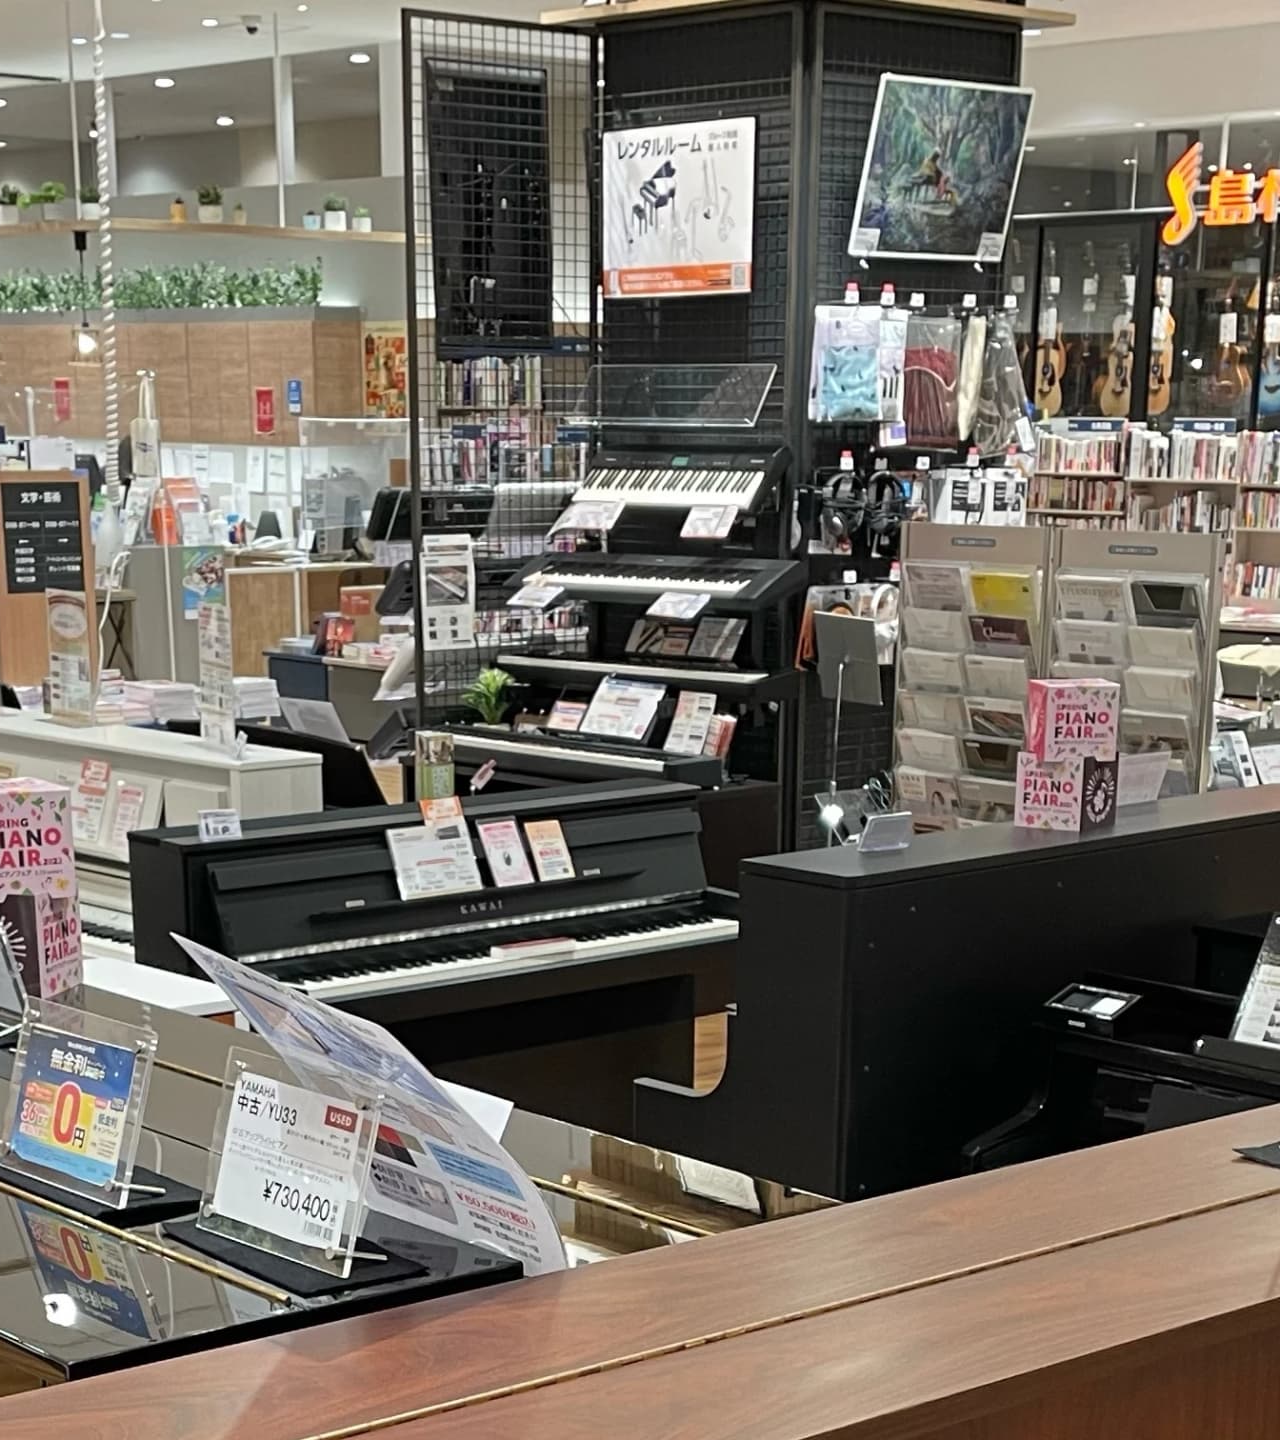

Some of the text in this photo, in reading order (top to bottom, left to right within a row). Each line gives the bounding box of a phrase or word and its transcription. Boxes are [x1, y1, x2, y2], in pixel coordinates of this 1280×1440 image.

[618, 133, 702, 159] レンタルルーム
[1055, 711, 1110, 725] PIANO
[1054, 726, 1093, 739] FAIR
[1023, 779, 1074, 793] PIANO
[1023, 792, 1059, 808] FAIR
[460, 900, 503, 914] KAWAI
[43, 917, 77, 946] PIANO
[45, 941, 69, 965] FAIR
[239, 1079, 277, 1100] YAMAHA
[237, 1094, 298, 1126] 中古/YU33
[329, 1110, 353, 1128] USED
[72, 1127, 86, 1149] 円
[262, 1178, 331, 1222] ¥730,400
